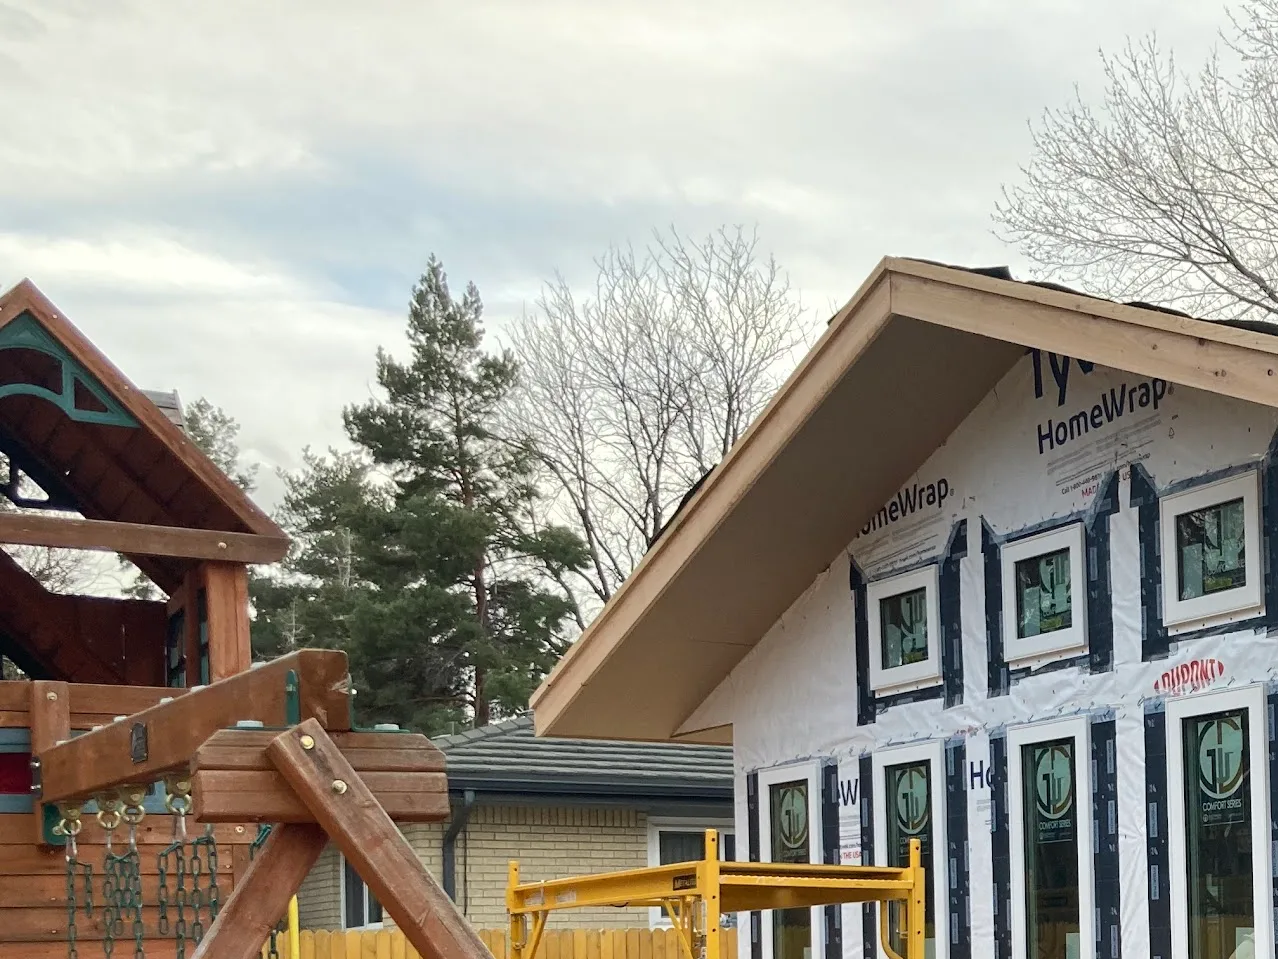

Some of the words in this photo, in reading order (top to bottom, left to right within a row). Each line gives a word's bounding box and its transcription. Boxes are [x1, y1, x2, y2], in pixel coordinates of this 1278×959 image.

[1024, 348, 1095, 407] Ty
[1037, 378, 1167, 455] HomeWrap
[856, 478, 949, 538] omeWrap
[1161, 659, 1216, 696] DUPONT
